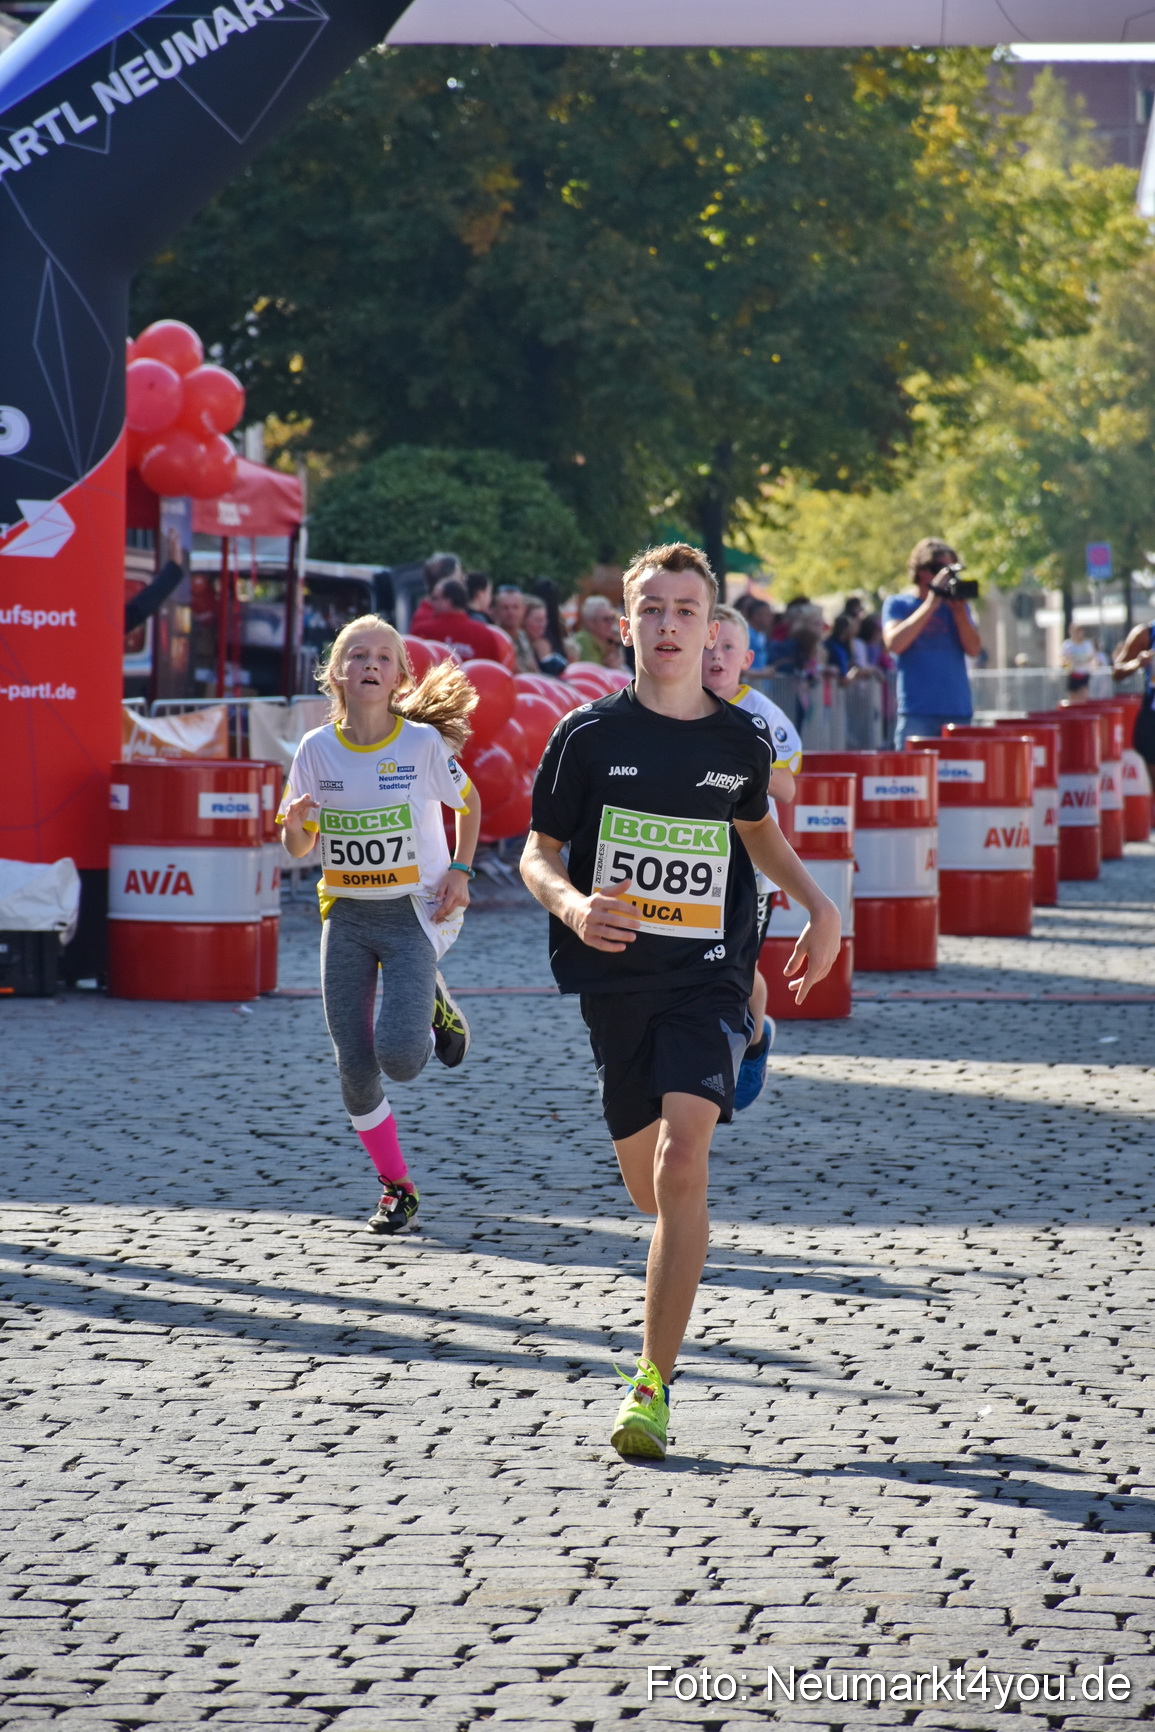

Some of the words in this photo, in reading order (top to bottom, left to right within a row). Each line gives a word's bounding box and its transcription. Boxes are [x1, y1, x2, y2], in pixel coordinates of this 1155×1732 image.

[91, 0, 285, 115] NEUMAR
[379, 762, 397, 774] 20
[608, 766, 638, 776] JAKO
[319, 780, 343, 788] BOCK
[379, 774, 418, 782] Neumarkter
[379, 782, 411, 790] Stadtlauf
[696, 771, 736, 788] JURA
[325, 808, 404, 832] BOCK
[611, 814, 720, 852] BOCK
[984, 822, 1031, 848] AVIA
[330, 836, 403, 866] 5007
[124, 864, 194, 896] AVIA
[342, 872, 398, 885] SOPHIA
[610, 850, 713, 897] 5089
[704, 944, 726, 961] 49
